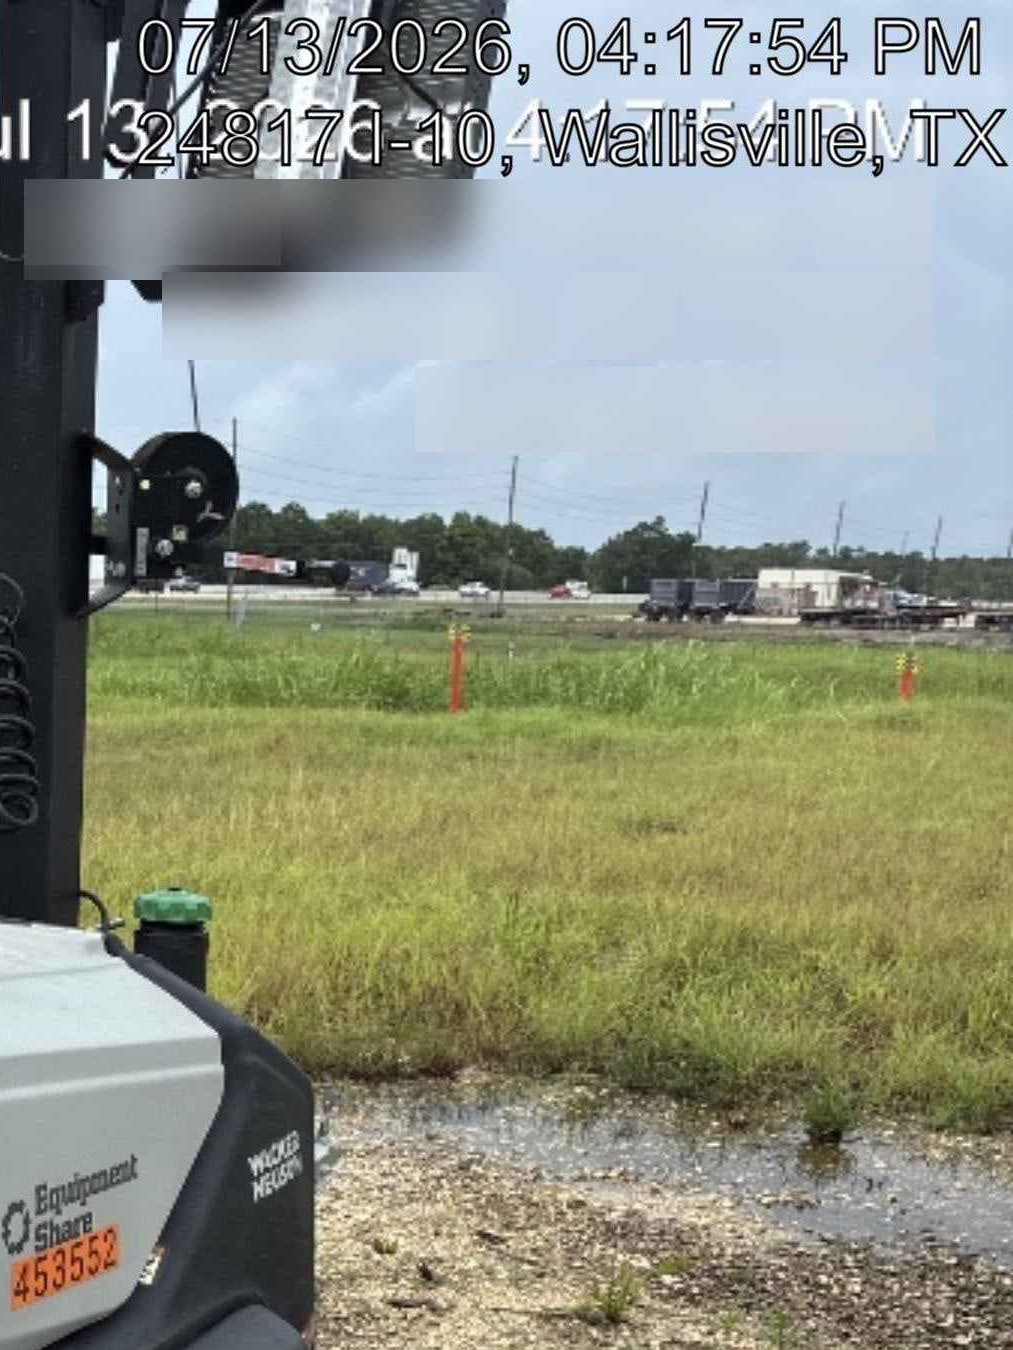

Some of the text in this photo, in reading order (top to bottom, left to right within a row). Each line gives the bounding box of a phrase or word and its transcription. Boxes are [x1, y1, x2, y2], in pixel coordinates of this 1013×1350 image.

[35, 1154, 137, 1216] Equipment
[35, 1211, 93, 1252] Share
[14, 1228, 117, 1302] 453552
